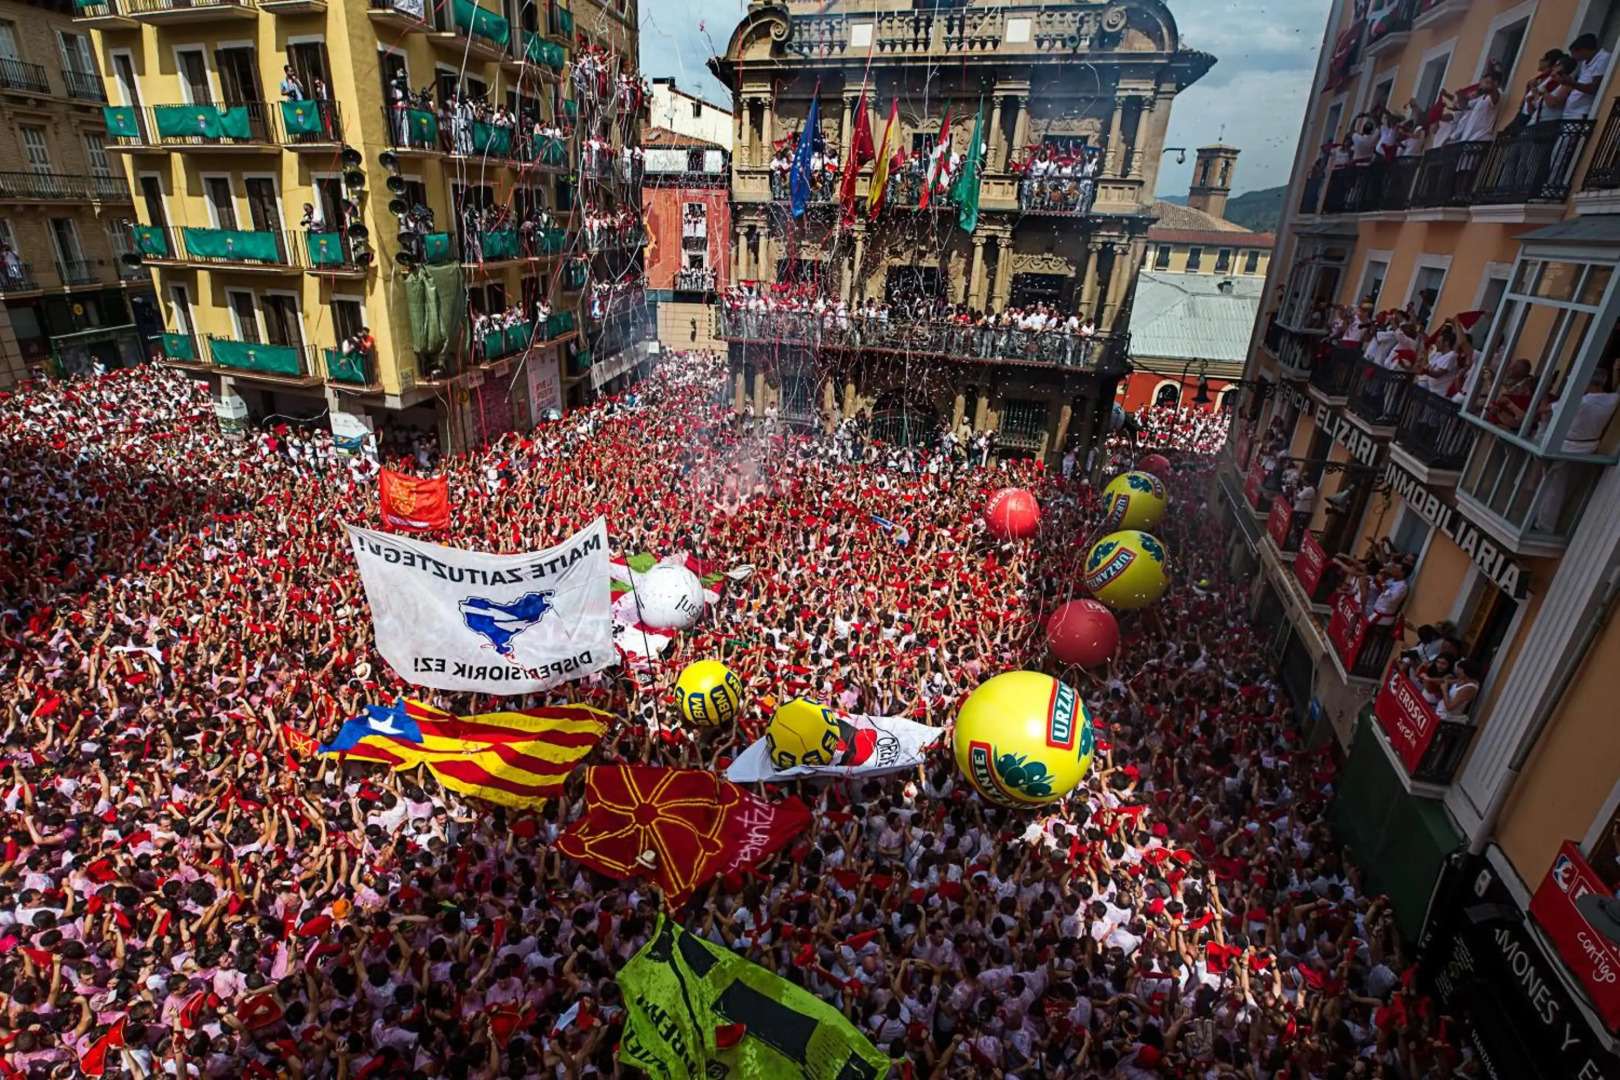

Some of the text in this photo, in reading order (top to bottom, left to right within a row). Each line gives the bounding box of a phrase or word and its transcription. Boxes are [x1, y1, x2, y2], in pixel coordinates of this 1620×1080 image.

[1279, 380, 1520, 600] GENCIA ELIZARI INMOBILIARIA
[1054, 680, 1076, 738] URZAN
[1398, 688, 1427, 731] EROSKI
[974, 753, 1002, 797] ANTE
[1577, 931, 1617, 983] contigo
[1560, 1022, 1583, 1052] Y
